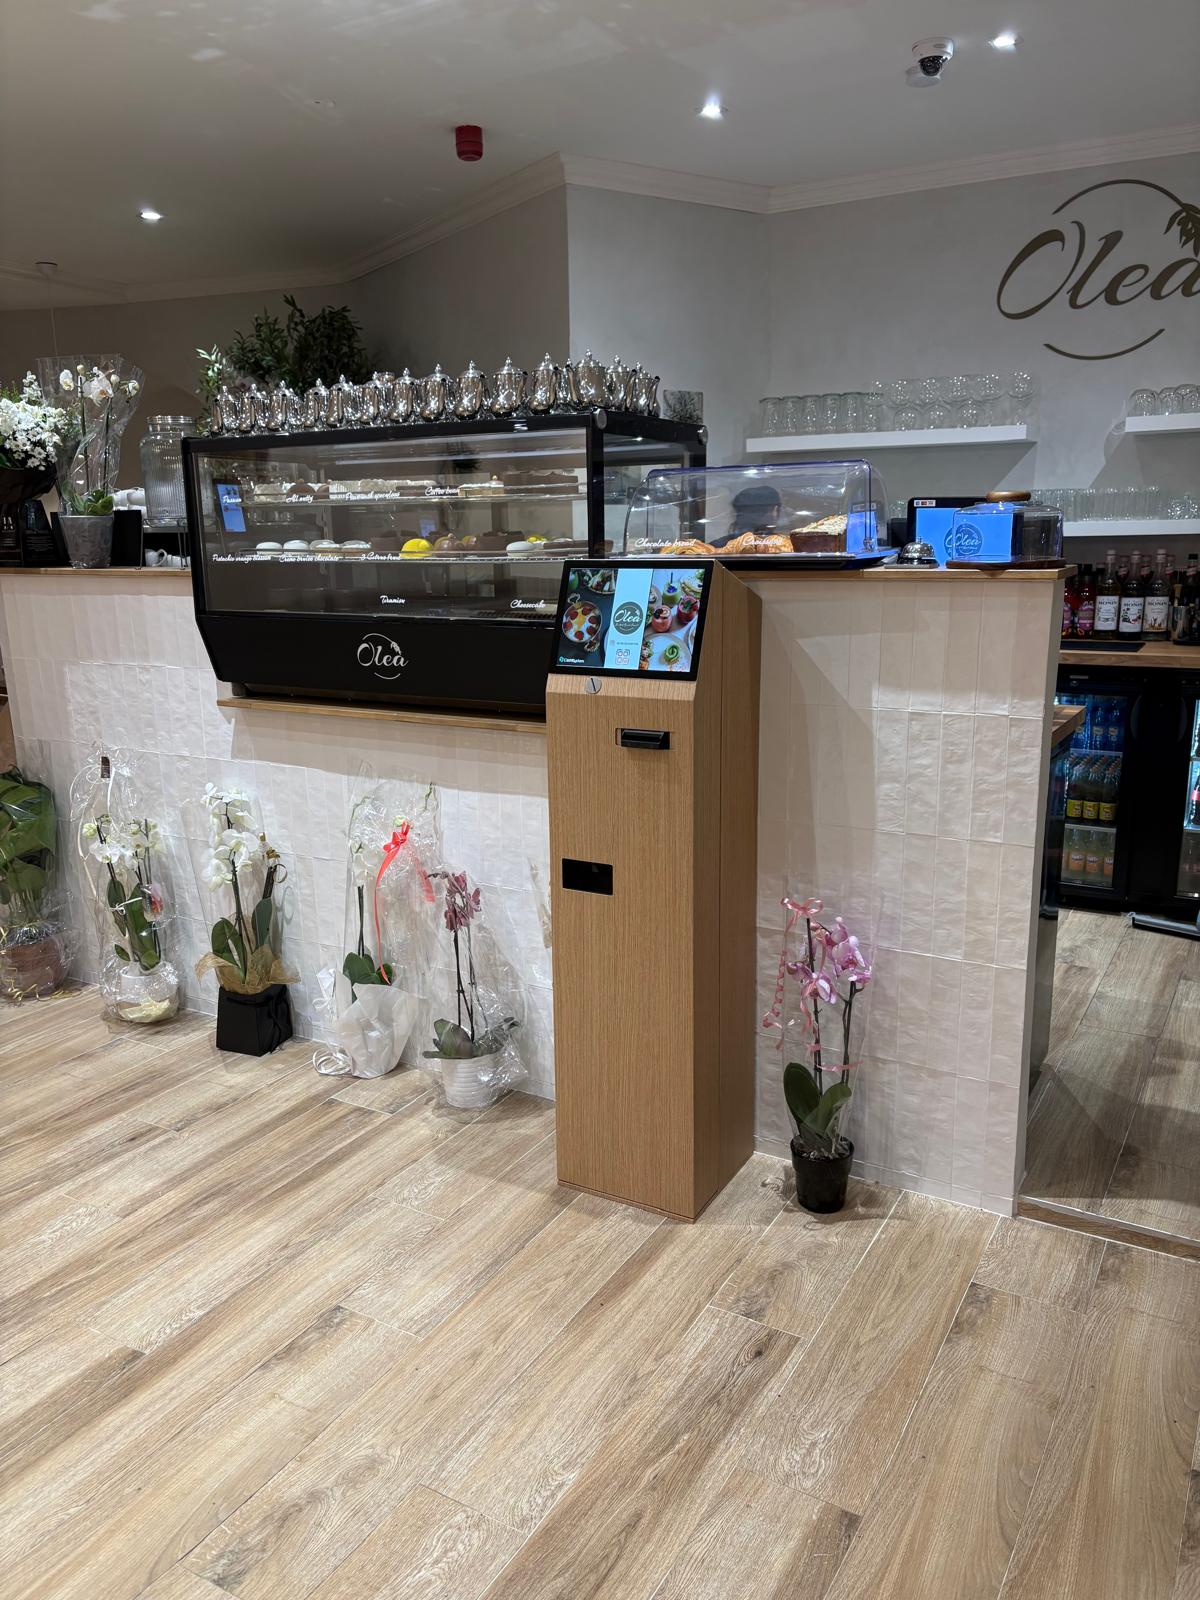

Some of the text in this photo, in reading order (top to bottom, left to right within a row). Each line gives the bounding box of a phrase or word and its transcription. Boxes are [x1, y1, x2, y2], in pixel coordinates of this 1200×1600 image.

[996, 220, 1200, 320] Olea
[634, 538, 697, 547] Chocolate bread
[510, 599, 547, 609] Cheesecake
[614, 609, 642, 623] Olea
[357, 641, 409, 667] Olea
